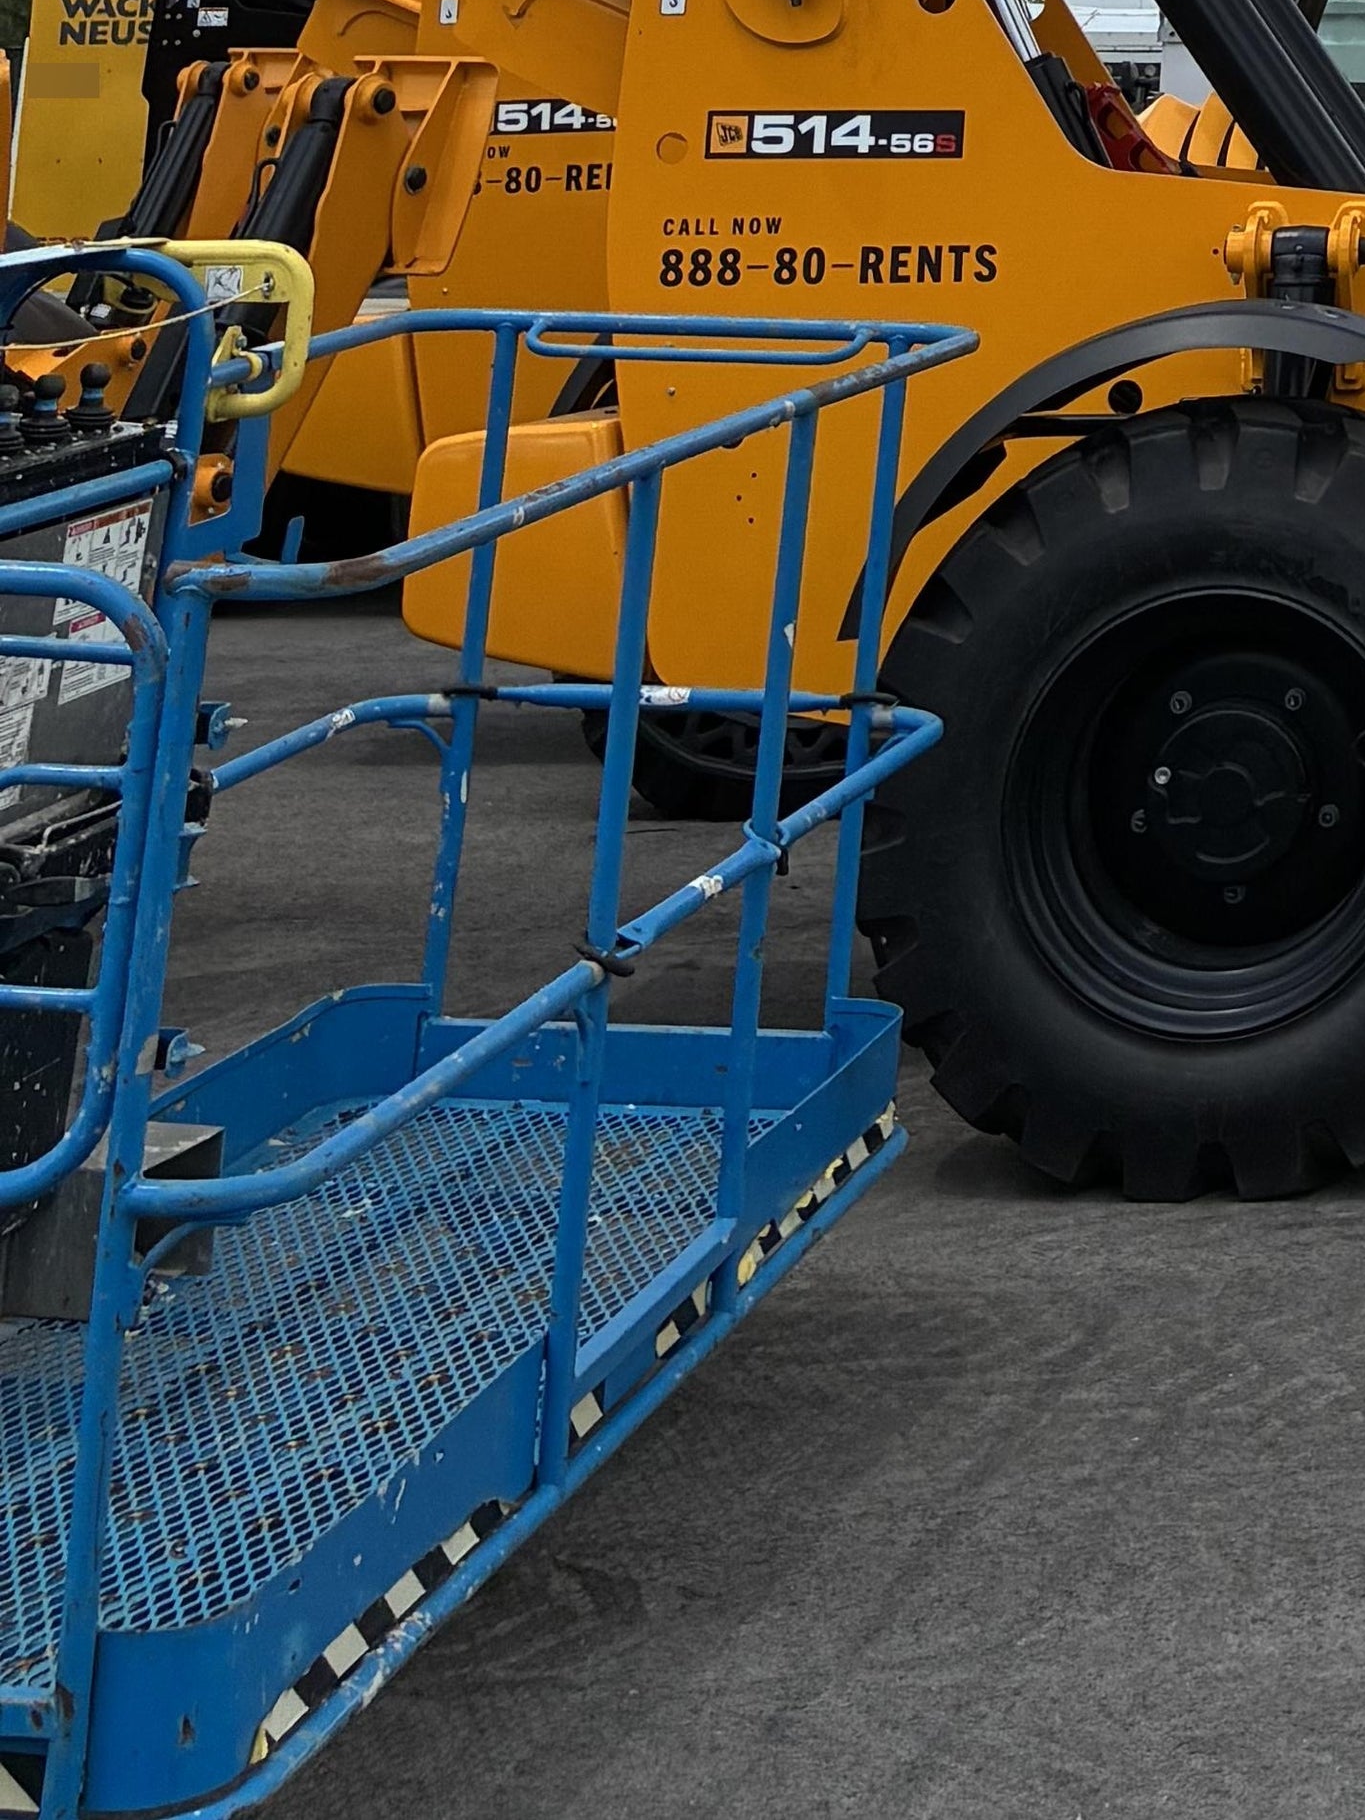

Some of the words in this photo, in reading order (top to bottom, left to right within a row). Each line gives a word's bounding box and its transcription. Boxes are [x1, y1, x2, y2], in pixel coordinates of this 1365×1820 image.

[59, 20, 152, 46] NEUS
[496, 102, 617, 133] 514-5
[751, 114, 956, 154] 514-56S
[487, 146, 510, 158] OW
[662, 217, 719, 236] CALL
[732, 216, 782, 235] NOW
[659, 244, 998, 288] 888-80-RENTS
